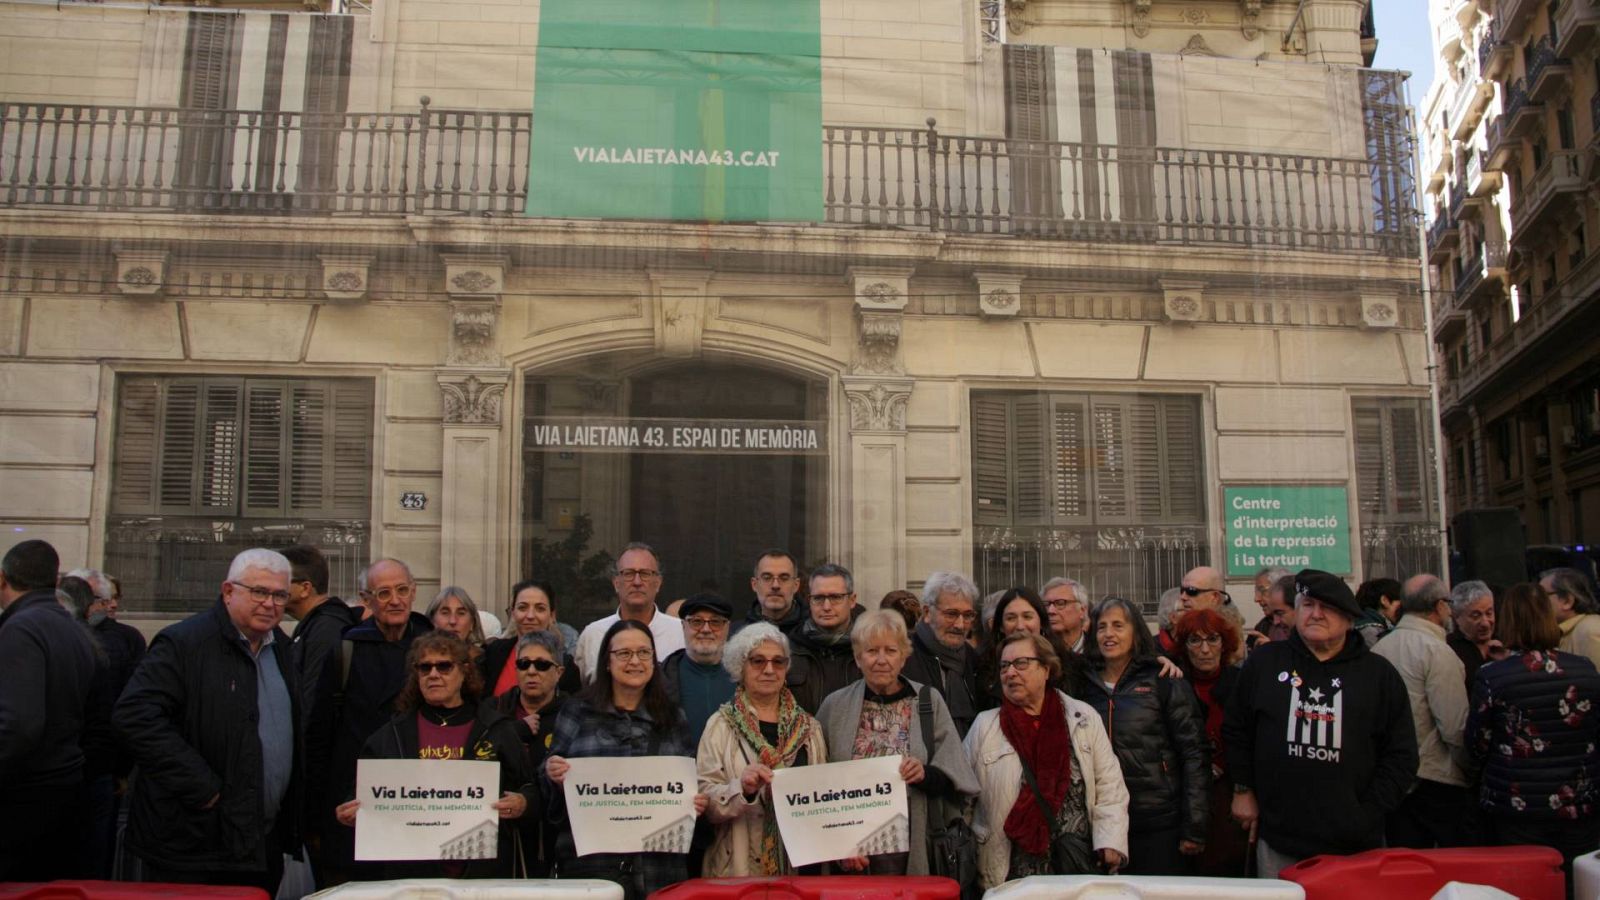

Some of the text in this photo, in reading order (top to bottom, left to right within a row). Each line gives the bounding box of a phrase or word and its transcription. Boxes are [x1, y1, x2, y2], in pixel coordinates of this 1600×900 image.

[574, 147, 779, 167] VIALAIETANA43.CAT
[534, 425, 818, 449] VIA LAIETANA 43. ESPAI DE MEMÒRIA
[404, 494, 424, 507] 43
[1232, 497, 1280, 509] Centre
[1233, 516, 1337, 531] d'interpretació
[1234, 534, 1336, 549] de la repressió
[1235, 554, 1310, 566] i la tortura
[1288, 744, 1340, 763] HI SOM
[371, 786, 484, 798] Via Laietana 43
[575, 782, 684, 795] Via Laietana 43
[786, 782, 892, 807] Via Laietana 43
[791, 810, 805, 818] FEM
[841, 804, 855, 812] FEM
